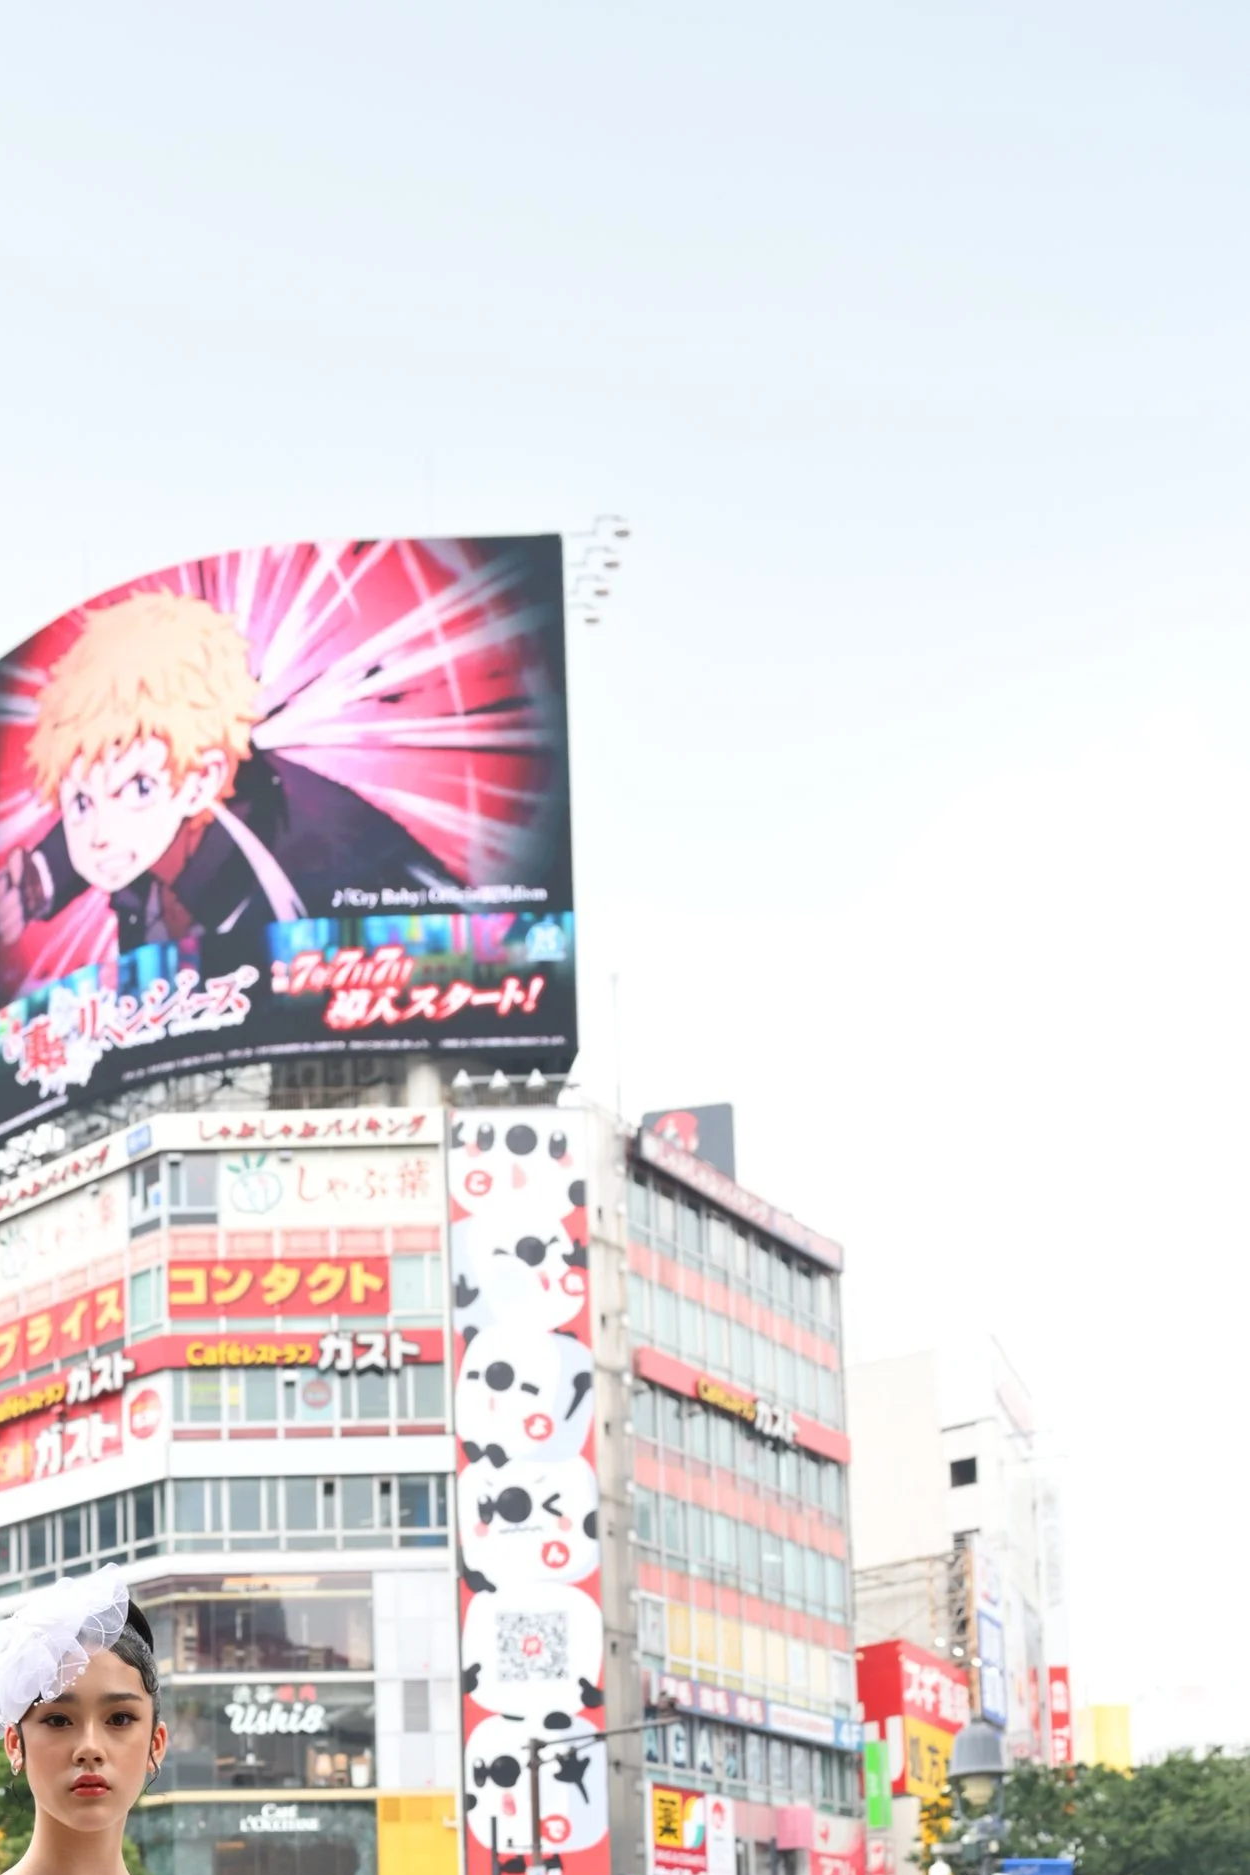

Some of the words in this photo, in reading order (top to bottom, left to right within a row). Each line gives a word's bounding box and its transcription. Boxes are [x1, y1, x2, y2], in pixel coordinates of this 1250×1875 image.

[168, 1261, 384, 1306] コンタクト
[318, 1331, 421, 1371] ガスト
[66, 1351, 136, 1405] ガスト
[33, 1411, 119, 1480] ガスト
